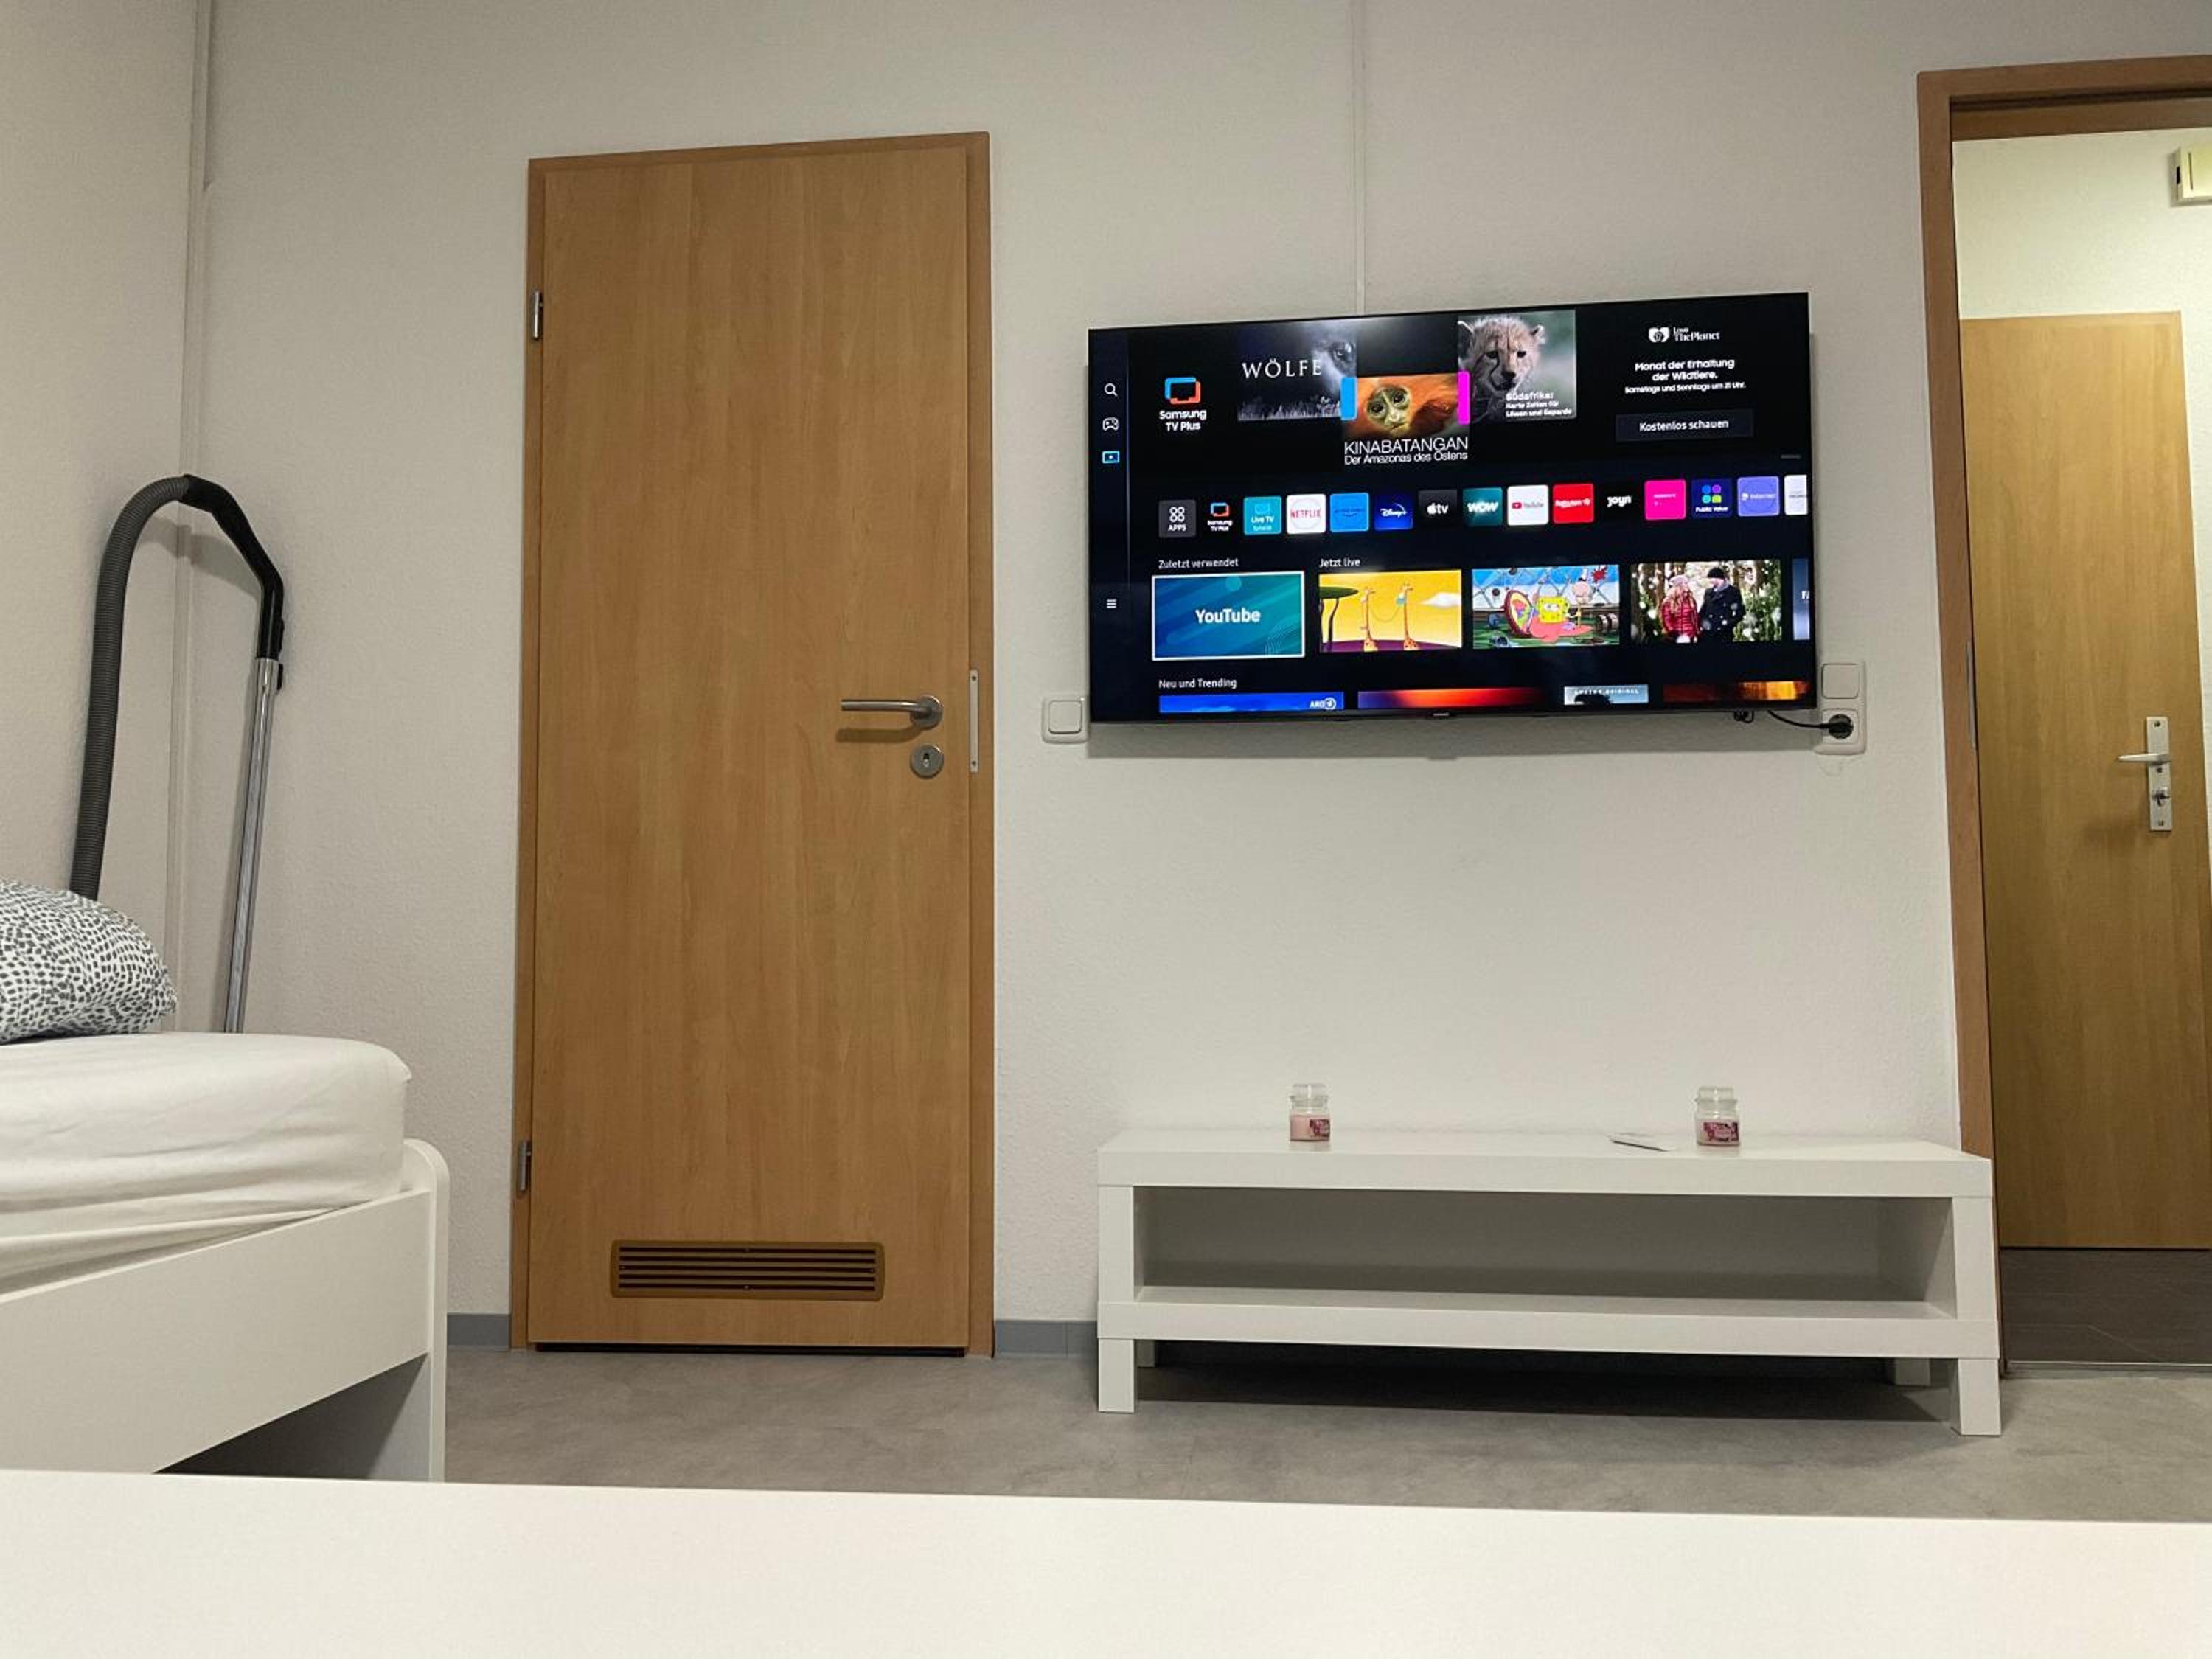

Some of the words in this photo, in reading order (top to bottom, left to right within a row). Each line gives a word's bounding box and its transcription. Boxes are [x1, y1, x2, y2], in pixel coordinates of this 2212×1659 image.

[1242, 358, 1322, 378] WÖLFE
[1635, 361, 1666, 372] Monat
[1667, 361, 1686, 370] der
[1687, 359, 1735, 369] Erhaltung
[1652, 372, 1670, 381] der
[1672, 371, 1718, 381] Wildtiere.
[1677, 383, 1710, 392] Sonntags
[1159, 410, 1207, 420] Samsung
[1165, 421, 1179, 431] TV
[1180, 421, 1201, 431] Plus
[1639, 420, 1687, 431] Kostenlos
[1688, 420, 1729, 430] schauen
[1344, 436, 1468, 455] KINABATANGAN
[1344, 455, 1362, 465] Der
[1363, 453, 1412, 464] Amazonas
[1413, 452, 1432, 462] des
[1433, 451, 1468, 461] Ostens
[1291, 509, 1321, 519] NETFLIX
[1168, 524, 1186, 532] APPS
[1158, 560, 1191, 569] Zuletzt
[1192, 558, 1239, 568] verwendet
[1320, 559, 1342, 568] Jetzt
[1343, 558, 1360, 567] live
[1195, 608, 1261, 624] YouTube
[1159, 679, 1177, 688] Neu
[1178, 678, 1195, 688] und
[1197, 678, 1237, 689] Trending
